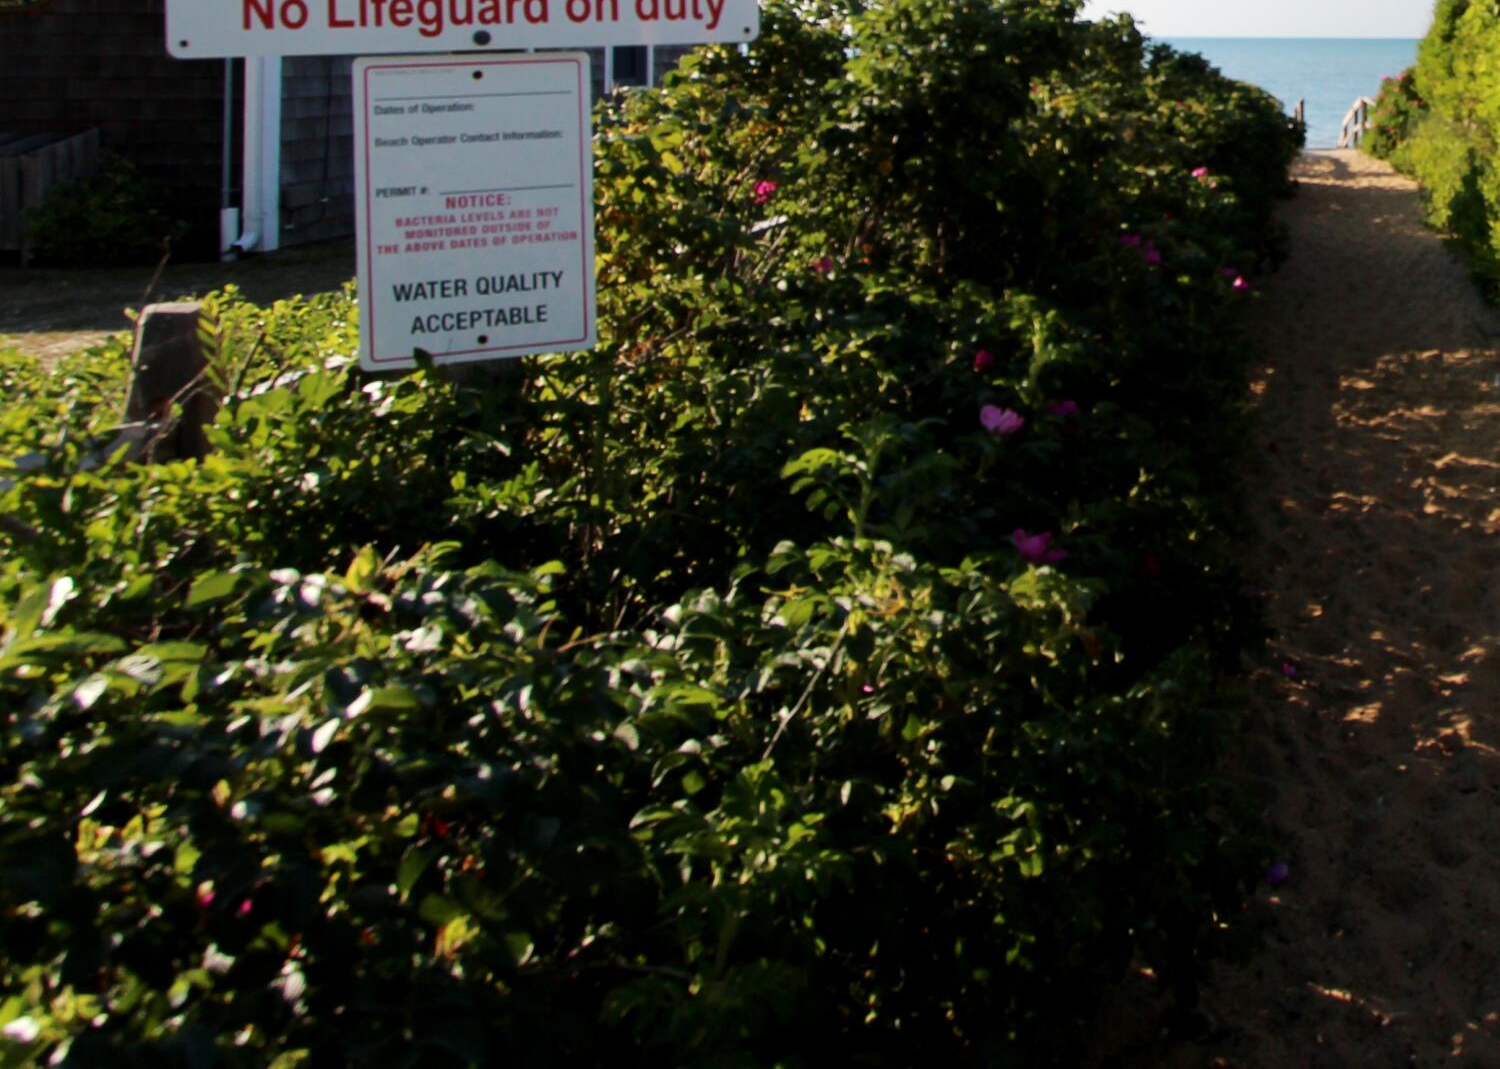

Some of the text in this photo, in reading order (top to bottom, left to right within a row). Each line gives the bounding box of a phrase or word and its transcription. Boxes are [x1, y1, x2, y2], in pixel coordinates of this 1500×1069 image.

[374, 104, 405, 116] Dates
[407, 103, 419, 114] of
[374, 136, 409, 147] Beach
[411, 134, 457, 146] Operator
[461, 131, 500, 144] Contact
[375, 186, 416, 197] PERMIT
[444, 193, 511, 210] NOTICE:
[395, 207, 559, 228] BACTERIA LEVELS ARE NOT
[404, 220, 551, 240] MONITORED OUTSIDE OF
[377, 230, 578, 255] THE ABOVE DATES OF OPERATION
[392, 270, 564, 303] WATER QUALITY
[410, 304, 548, 335] ACCEPTABLE
